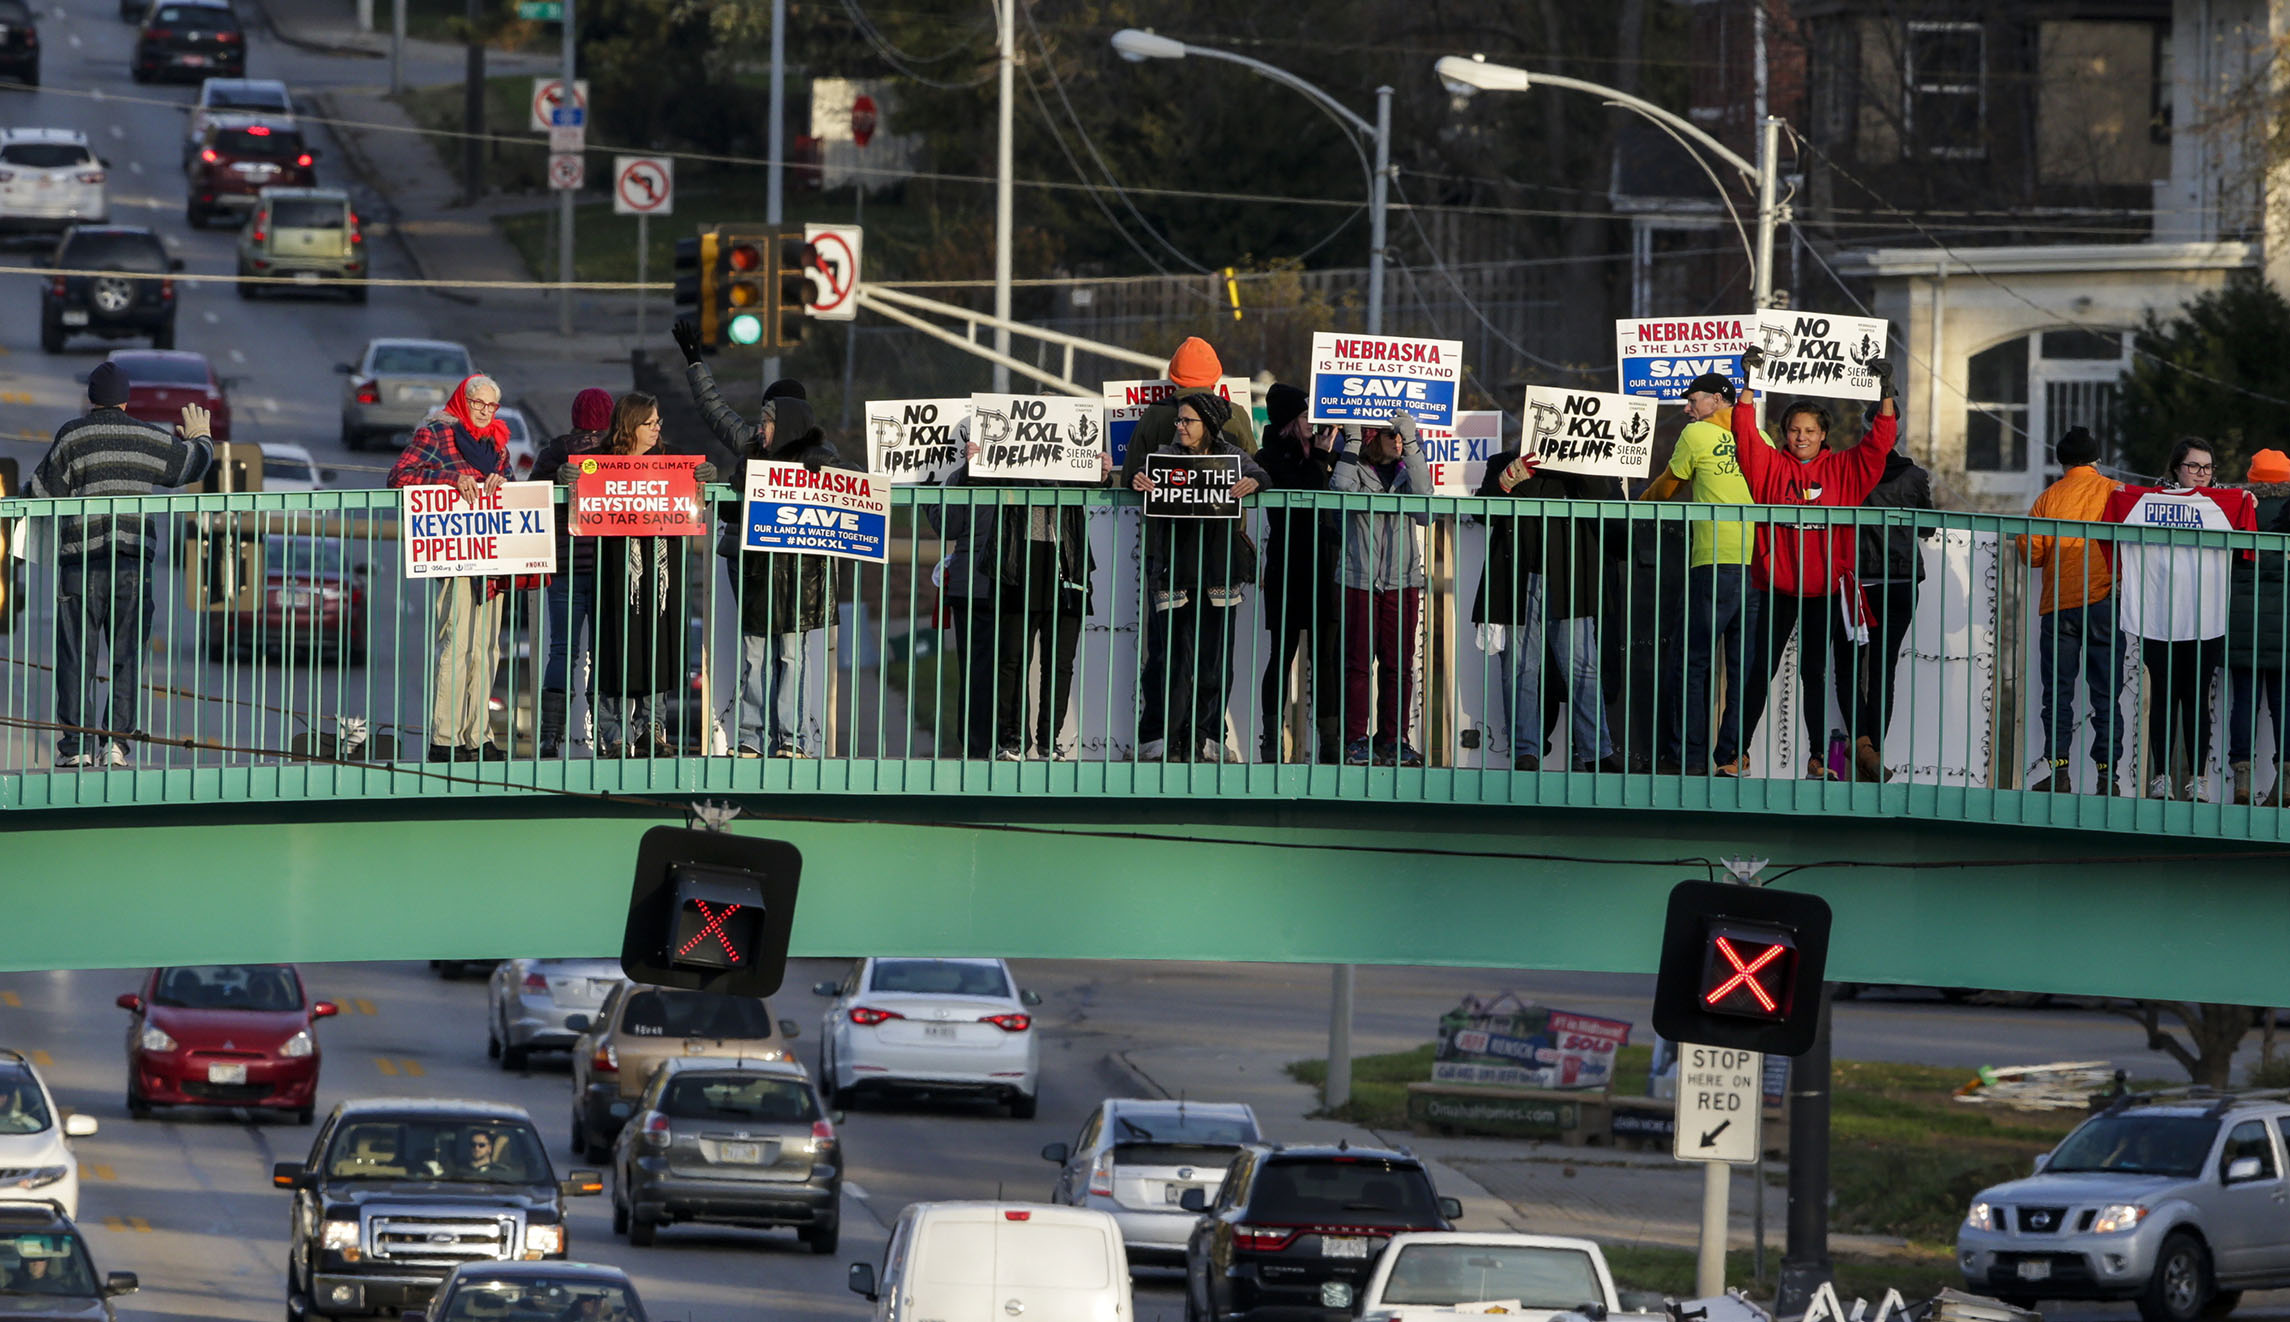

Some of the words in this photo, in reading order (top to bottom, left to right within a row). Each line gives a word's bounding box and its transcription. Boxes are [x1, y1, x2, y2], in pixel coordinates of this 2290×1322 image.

[1638, 321, 1743, 342] NEBRASKA
[1793, 317, 1830, 338] NO
[1335, 339, 1441, 364] NEBRASKA
[1625, 345, 1637, 355] IS
[1640, 344, 1668, 354] THE
[1674, 343, 1708, 353] LAST
[1797, 339, 1845, 361] KXL
[1319, 361, 1332, 371] IS
[1338, 361, 1363, 371] THE
[1369, 363, 1404, 373] LAST
[1409, 365, 1453, 378] STAND
[1650, 359, 1733, 378] SAVE
[1342, 377, 1427, 400] SAVE
[1629, 379, 1646, 387] OUR
[1649, 379, 1672, 387] LAND
[1673, 378, 1681, 387] &
[1850, 377, 1873, 388] CLUB
[1010, 400, 1047, 421] NO
[1112, 408, 1125, 418] IS
[1321, 397, 1338, 405] OUR
[1341, 397, 1363, 406] LAND
[1364, 398, 1371, 406] &
[1373, 398, 1402, 408] WATER
[1404, 400, 1447, 412] TOGETHER
[1563, 395, 1601, 417] NO
[903, 404, 938, 425] NO
[909, 425, 956, 446] KXL
[1015, 422, 1063, 444] KXL
[1567, 417, 1615, 440] KXL
[1066, 448, 1098, 459] SIERRA
[1467, 438, 1489, 461] XL
[1617, 445, 1648, 456] SIERRA
[634, 462, 649, 470] ON
[653, 461, 696, 470] CLIMATE
[1070, 459, 1094, 469] CLUB
[1620, 455, 1642, 466] CLUB
[769, 467, 871, 498] NEBRASKA
[1202, 469, 1236, 485] THE
[605, 480, 669, 495] REJECT
[1151, 488, 1235, 504] PIPELINE
[411, 489, 460, 513] STOP
[580, 497, 669, 512] KEYSTONE
[672, 496, 694, 512] XL
[753, 488, 766, 498] IS
[770, 489, 797, 500] THE
[803, 491, 837, 503] LAST
[842, 497, 884, 512] STAND
[580, 513, 603, 525] NO
[608, 513, 638, 525] TAR
[642, 513, 692, 525] SANDS
[776, 506, 859, 531] SAVE
[2147, 504, 2200, 523] PIPELINE
[411, 511, 513, 537] KEYSTONE
[519, 510, 545, 533] XL
[754, 524, 772, 534] OUR
[774, 526, 797, 535] LAND
[799, 527, 806, 535] &
[807, 527, 836, 538] WATER
[838, 531, 879, 545] TOGETHER
[787, 536, 847, 550] #NOKXL
[412, 536, 499, 562] PIPELINE
[1563, 1035, 1614, 1054] SOLD
[1692, 1049, 1750, 1070] STOP
[1687, 1073, 1723, 1086] HERE
[1732, 1075, 1752, 1088] ON
[1698, 1092, 1741, 1111] RED
